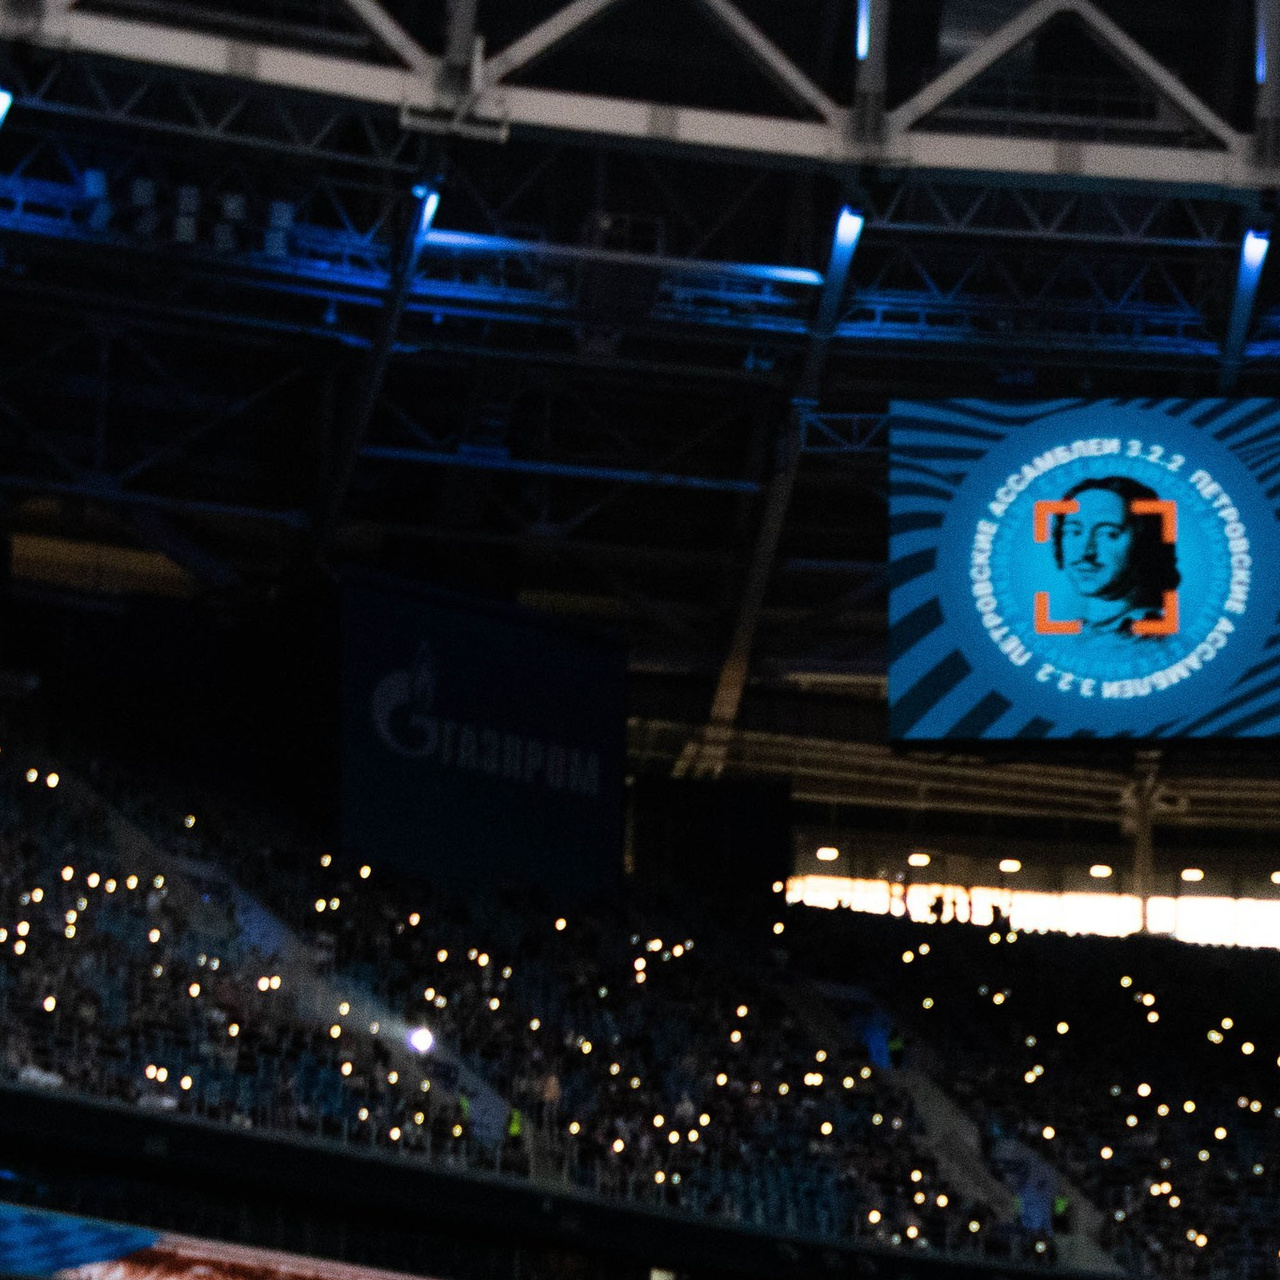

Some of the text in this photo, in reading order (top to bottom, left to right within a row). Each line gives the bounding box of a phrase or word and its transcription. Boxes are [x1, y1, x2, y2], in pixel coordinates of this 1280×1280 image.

[987, 437, 1121, 517] АССАМБЛЕИ
[1188, 468, 1253, 615] ПЕТРОВСКИЕ
[969, 518, 1033, 667] ПЕТРОВСКИЕ
